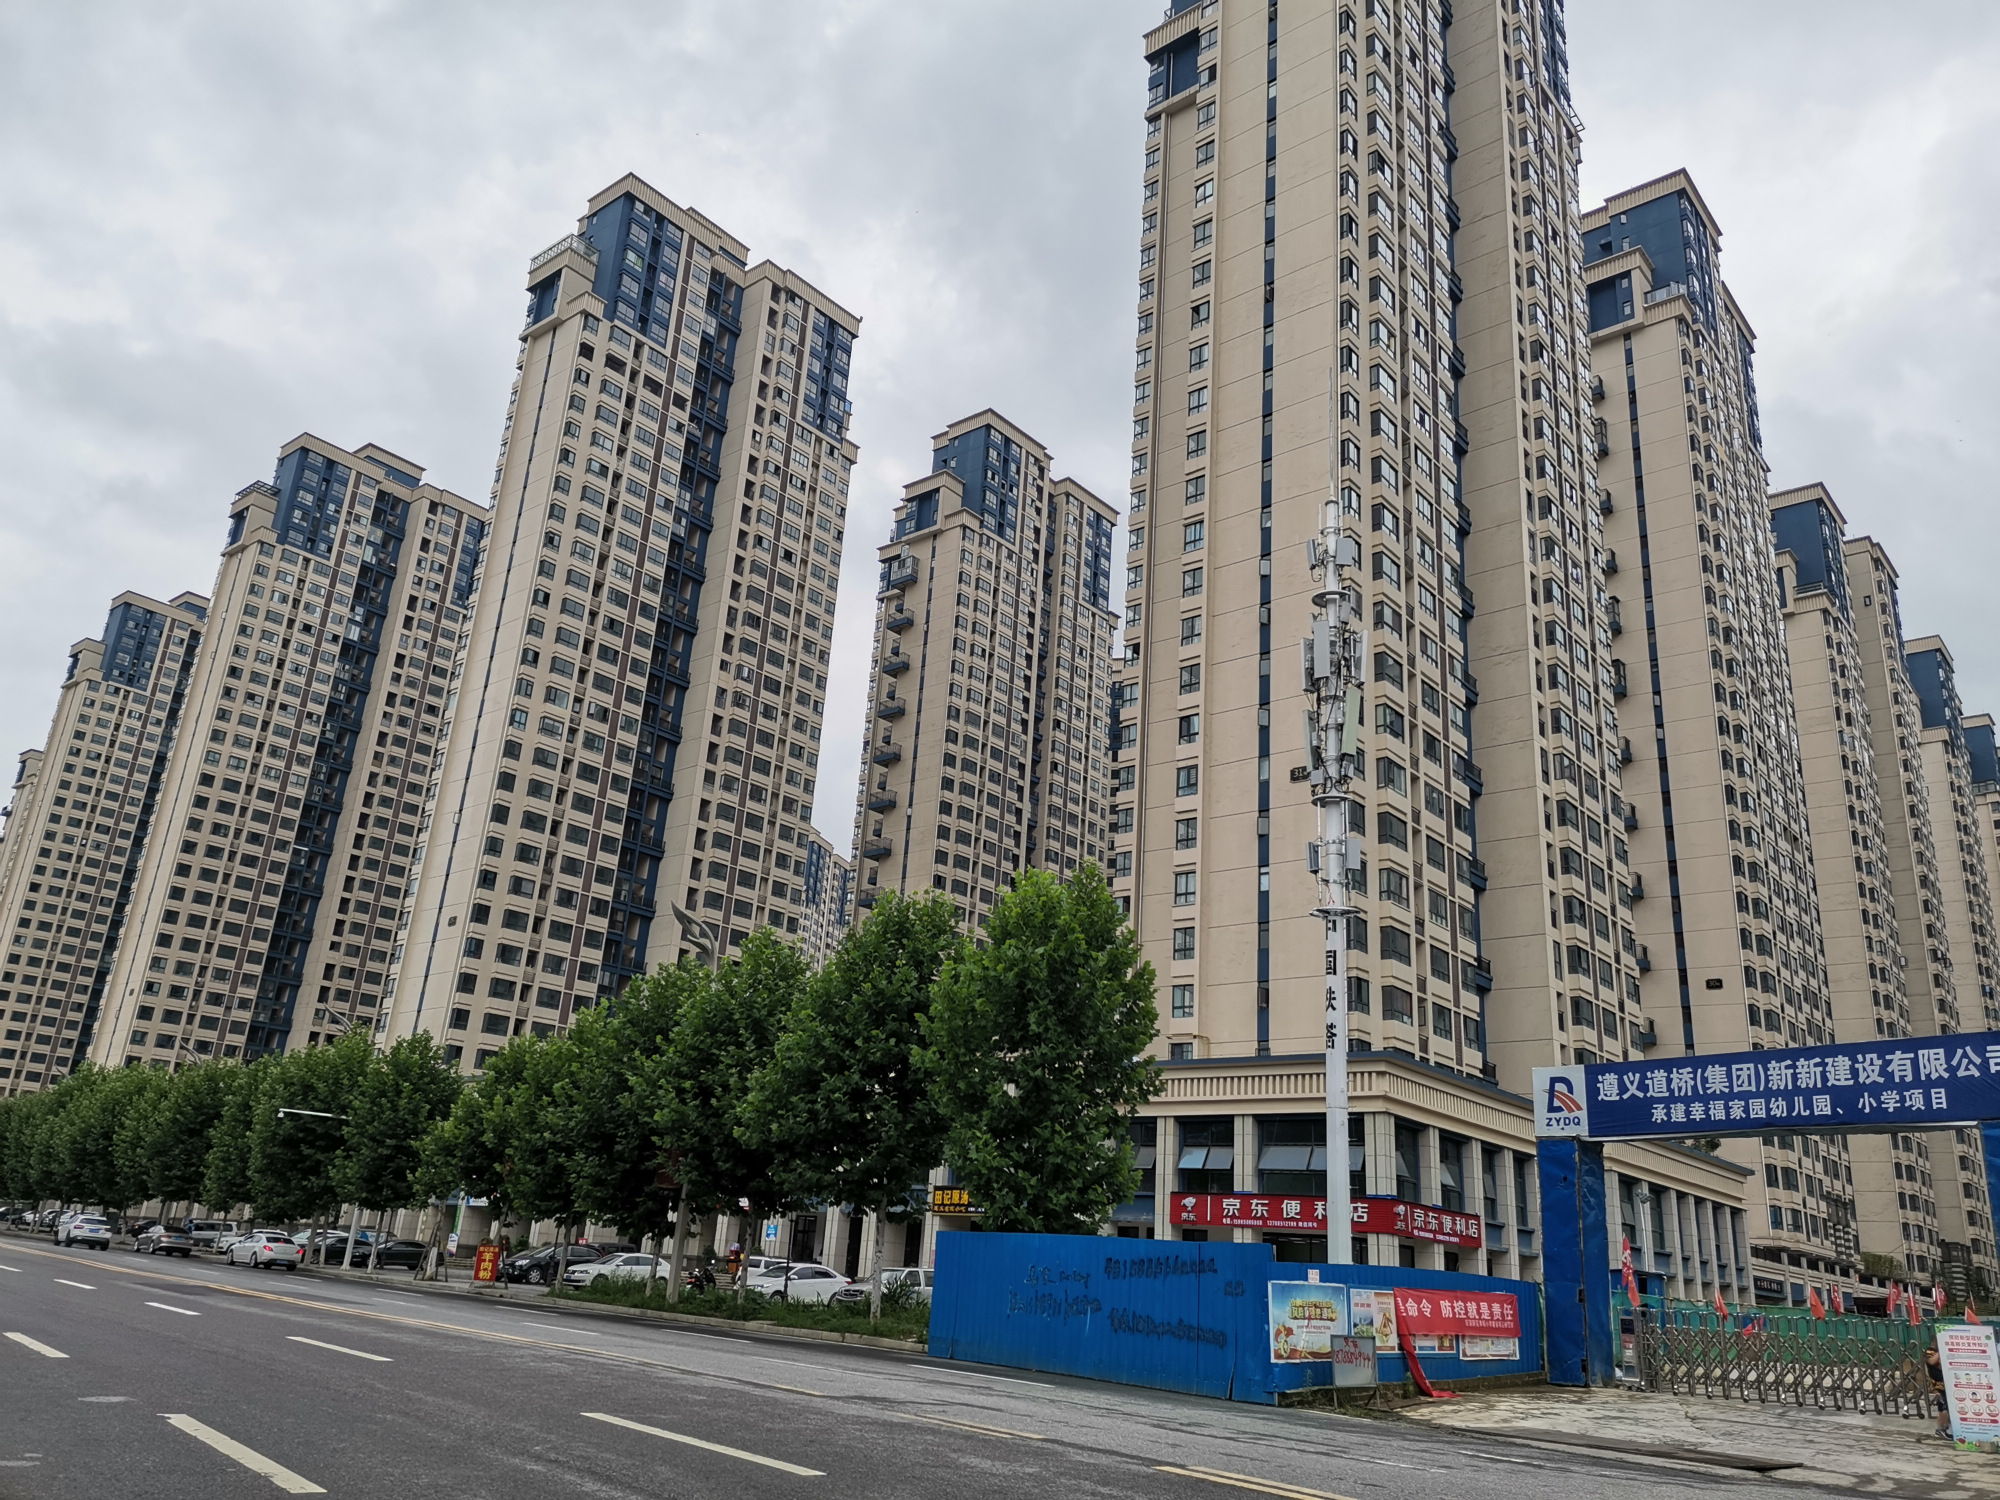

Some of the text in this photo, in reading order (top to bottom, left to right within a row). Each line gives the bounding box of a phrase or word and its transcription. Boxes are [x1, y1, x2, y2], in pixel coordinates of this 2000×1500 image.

[1651, 1088, 1948, 1123] 承建幸福家园幼儿园、小学项目
[1545, 1116, 1581, 1127] ZYDQ
[1413, 1209, 1479, 1238] 京东便利店
[478, 1252, 495, 1280] 羊肉粉
[1440, 1300, 1513, 1321] 防控就是责任
